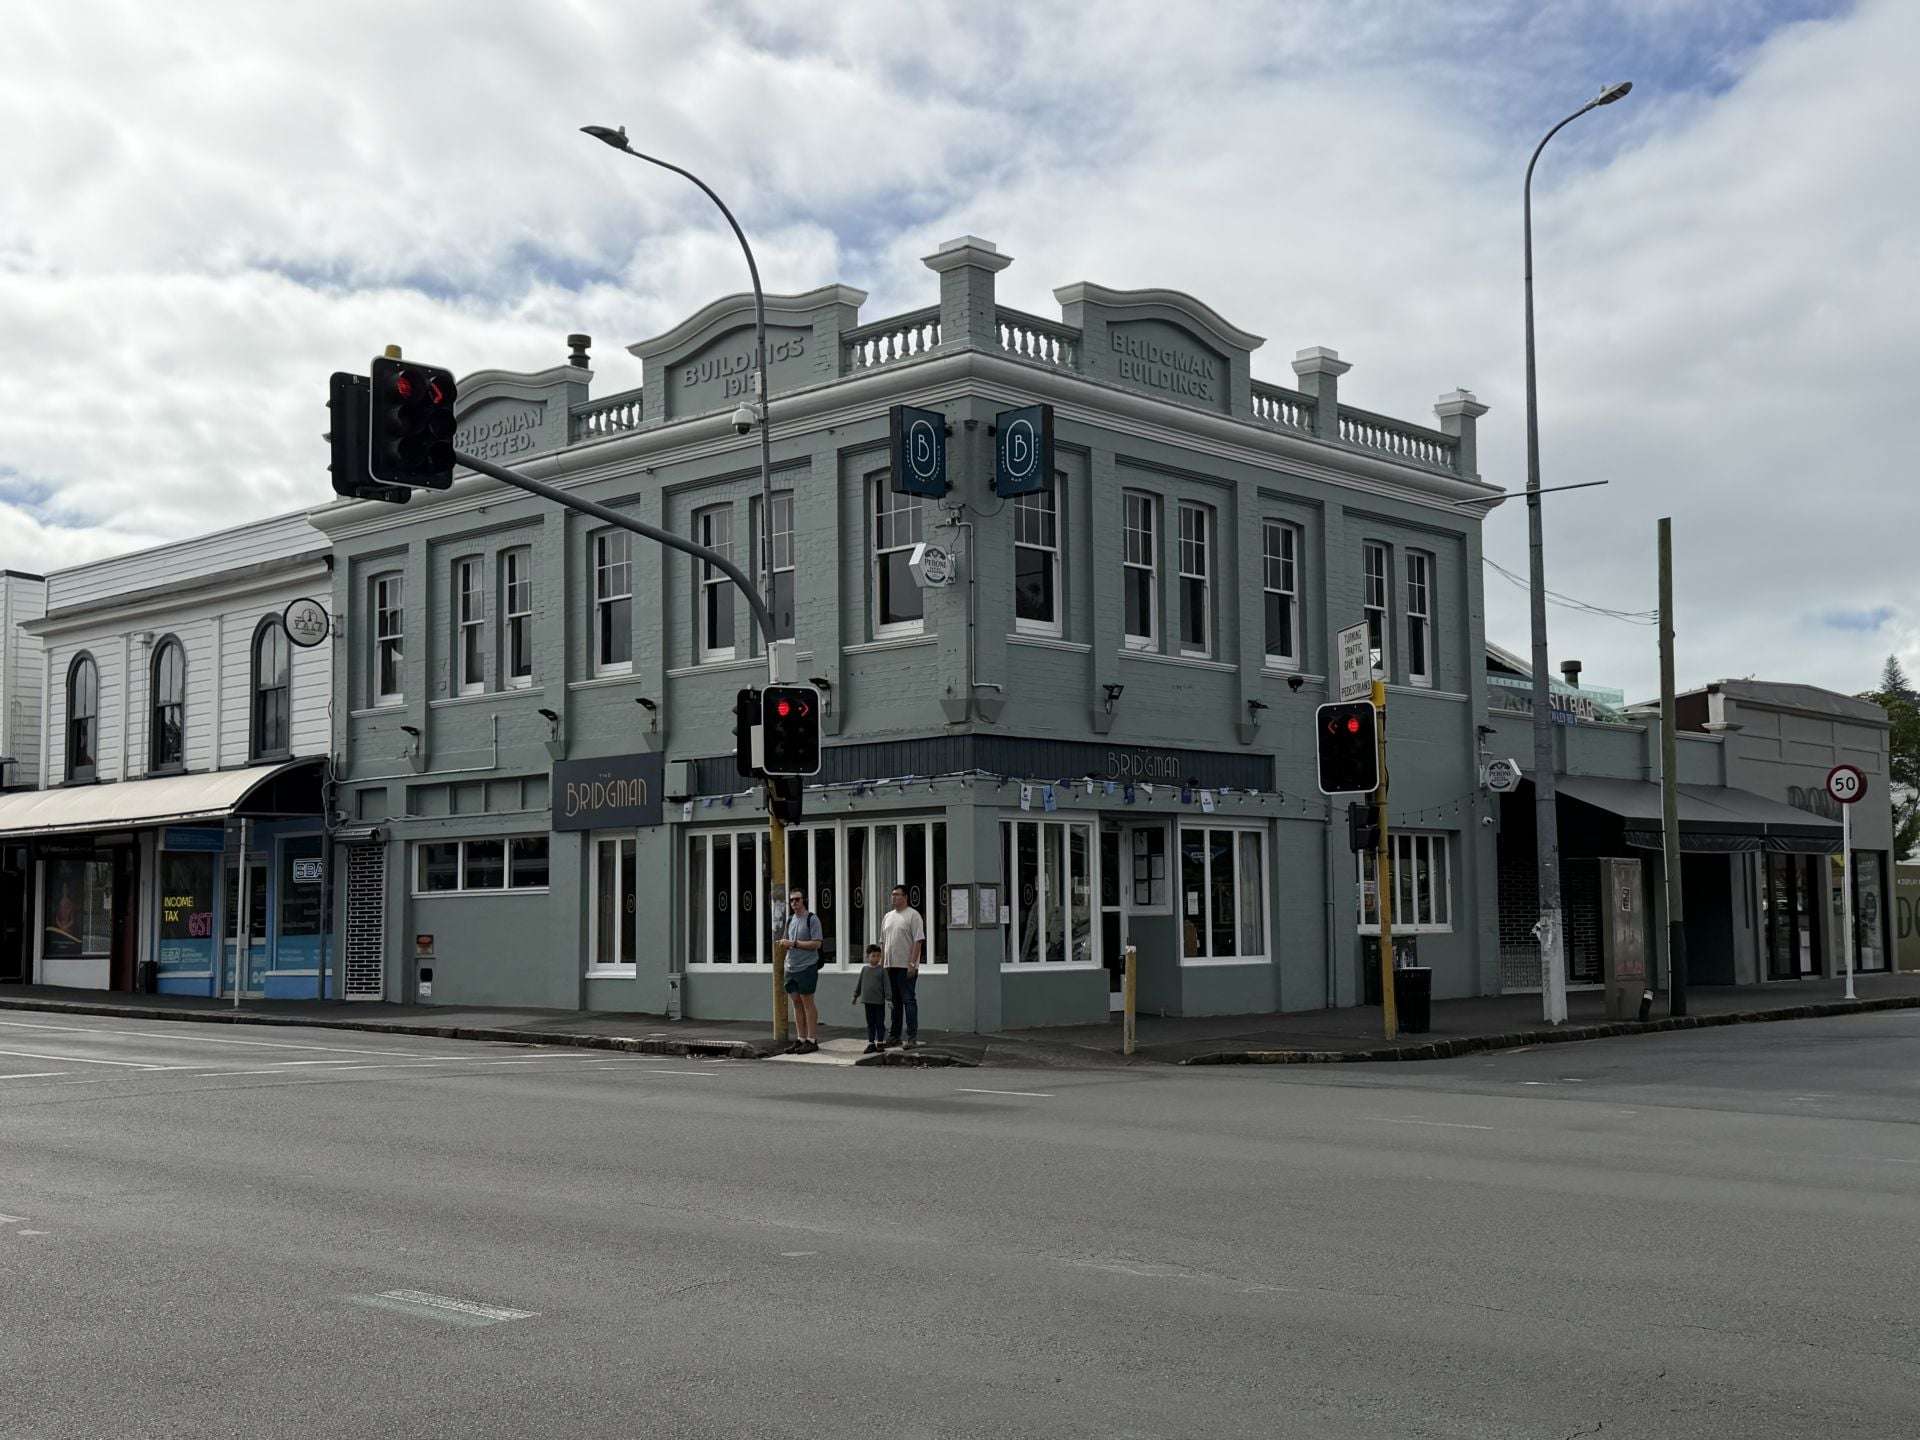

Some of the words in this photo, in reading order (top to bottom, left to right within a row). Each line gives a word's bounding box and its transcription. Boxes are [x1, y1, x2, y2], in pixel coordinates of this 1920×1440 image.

[1110, 329, 1216, 381] BRIDGMAN
[1118, 357, 1215, 402] BUILDINGS.
[463, 432, 536, 461] RECTED.
[917, 434, 930, 462] B
[1013, 434, 1028, 462] B
[1106, 751, 1180, 780] BRIDGMAN
[564, 778, 648, 817] BRIDGMAN
[1835, 776, 1857, 792] 50
[164, 896, 194, 907] INCOME
[165, 910, 179, 922] TAX
[189, 912, 213, 936] GST
